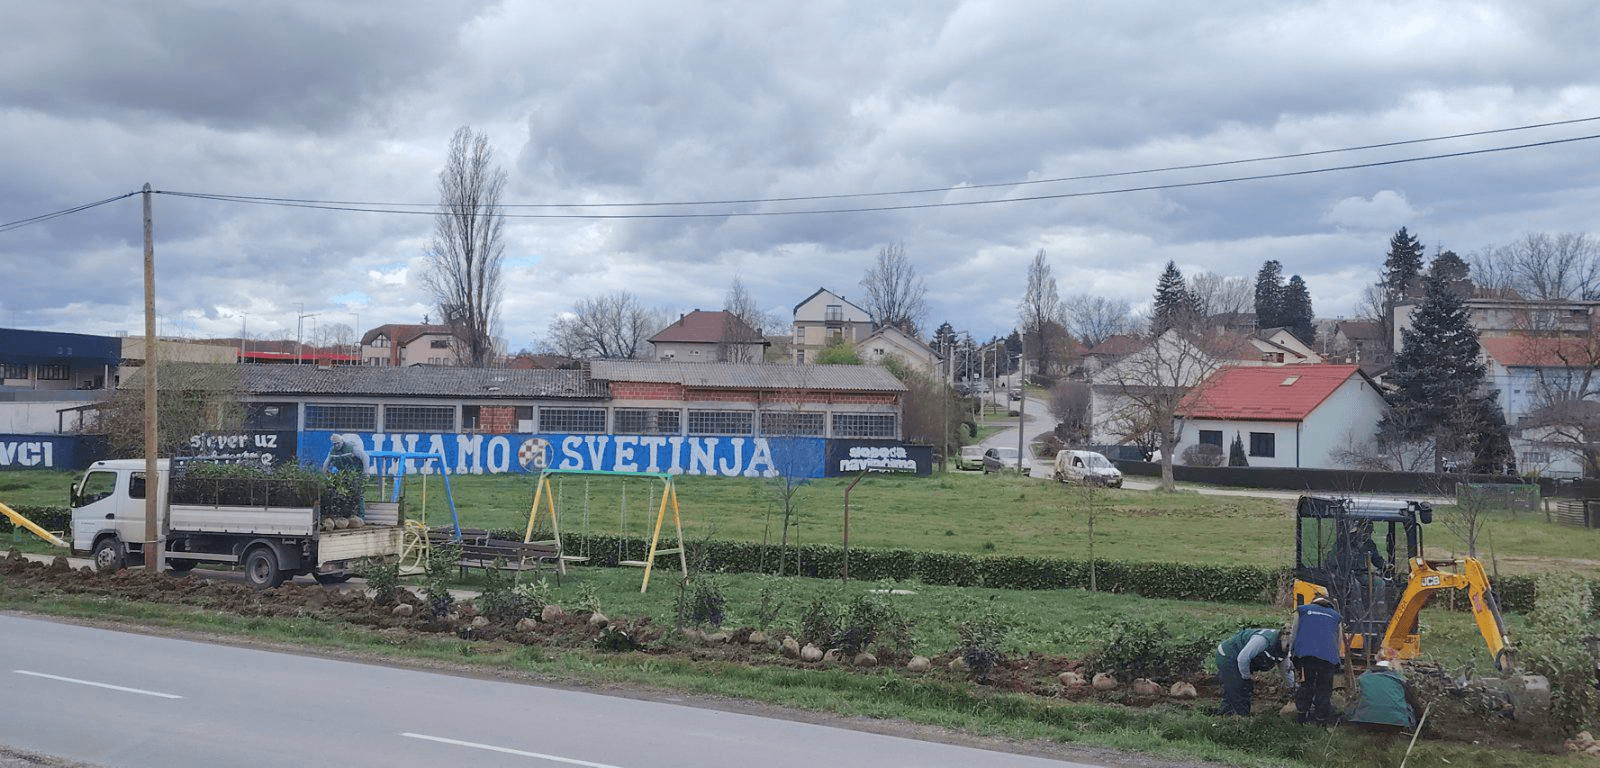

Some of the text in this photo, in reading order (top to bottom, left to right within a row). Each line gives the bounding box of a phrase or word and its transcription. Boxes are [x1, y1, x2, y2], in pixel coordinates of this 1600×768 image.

[254, 434, 278, 448] uz
[559, 435, 780, 478] SVETINJA
[1421, 575, 1440, 587] JCB
